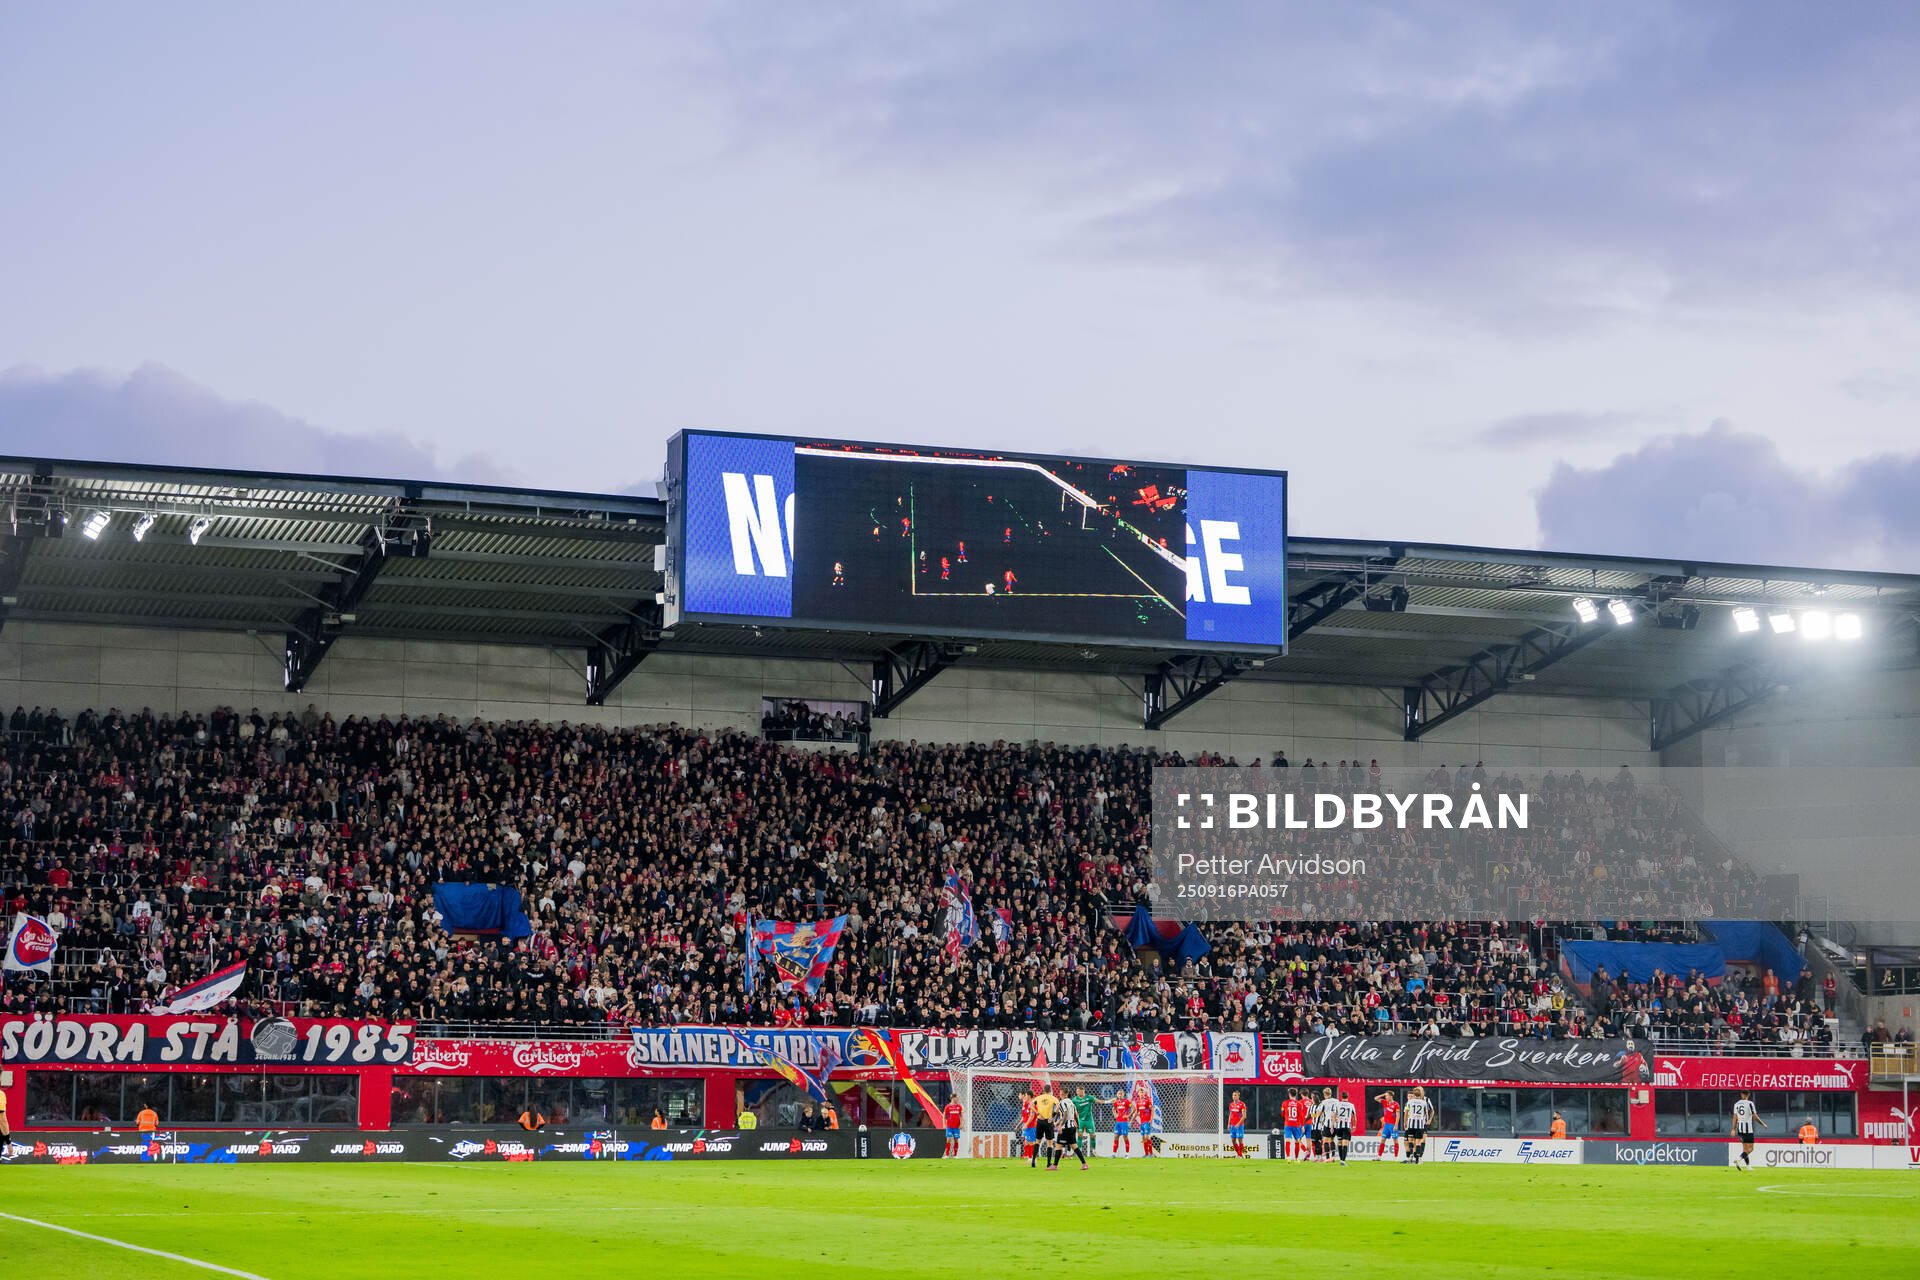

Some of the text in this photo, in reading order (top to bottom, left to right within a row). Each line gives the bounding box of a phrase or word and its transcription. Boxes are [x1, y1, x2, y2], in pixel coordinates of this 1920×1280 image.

[722, 472, 794, 577] N
[2, 1014, 412, 1062] SÖDRA STÅ 1985
[512, 1044, 581, 1072] Carlsberg
[1304, 1035, 1611, 1073] Vila i frid Sverker
[1287, 1106, 1297, 1118] 16
[1339, 1107, 1350, 1118] 21
[1412, 1104, 1423, 1115] 12
[160, 1145, 190, 1155] YARD
[226, 1144, 300, 1154] JUMP YARD
[330, 1144, 404, 1154] JUMP YARD
[452, 1143, 485, 1153] JUMP
[601, 1143, 629, 1153] YARD
[662, 1143, 732, 1152] JUMP YARD
[760, 1142, 828, 1152] JUMP YARD
[1169, 1143, 1210, 1151] Jönssons
[1615, 1143, 1698, 1163] kondektor
[1765, 1146, 1833, 1167] granitor
